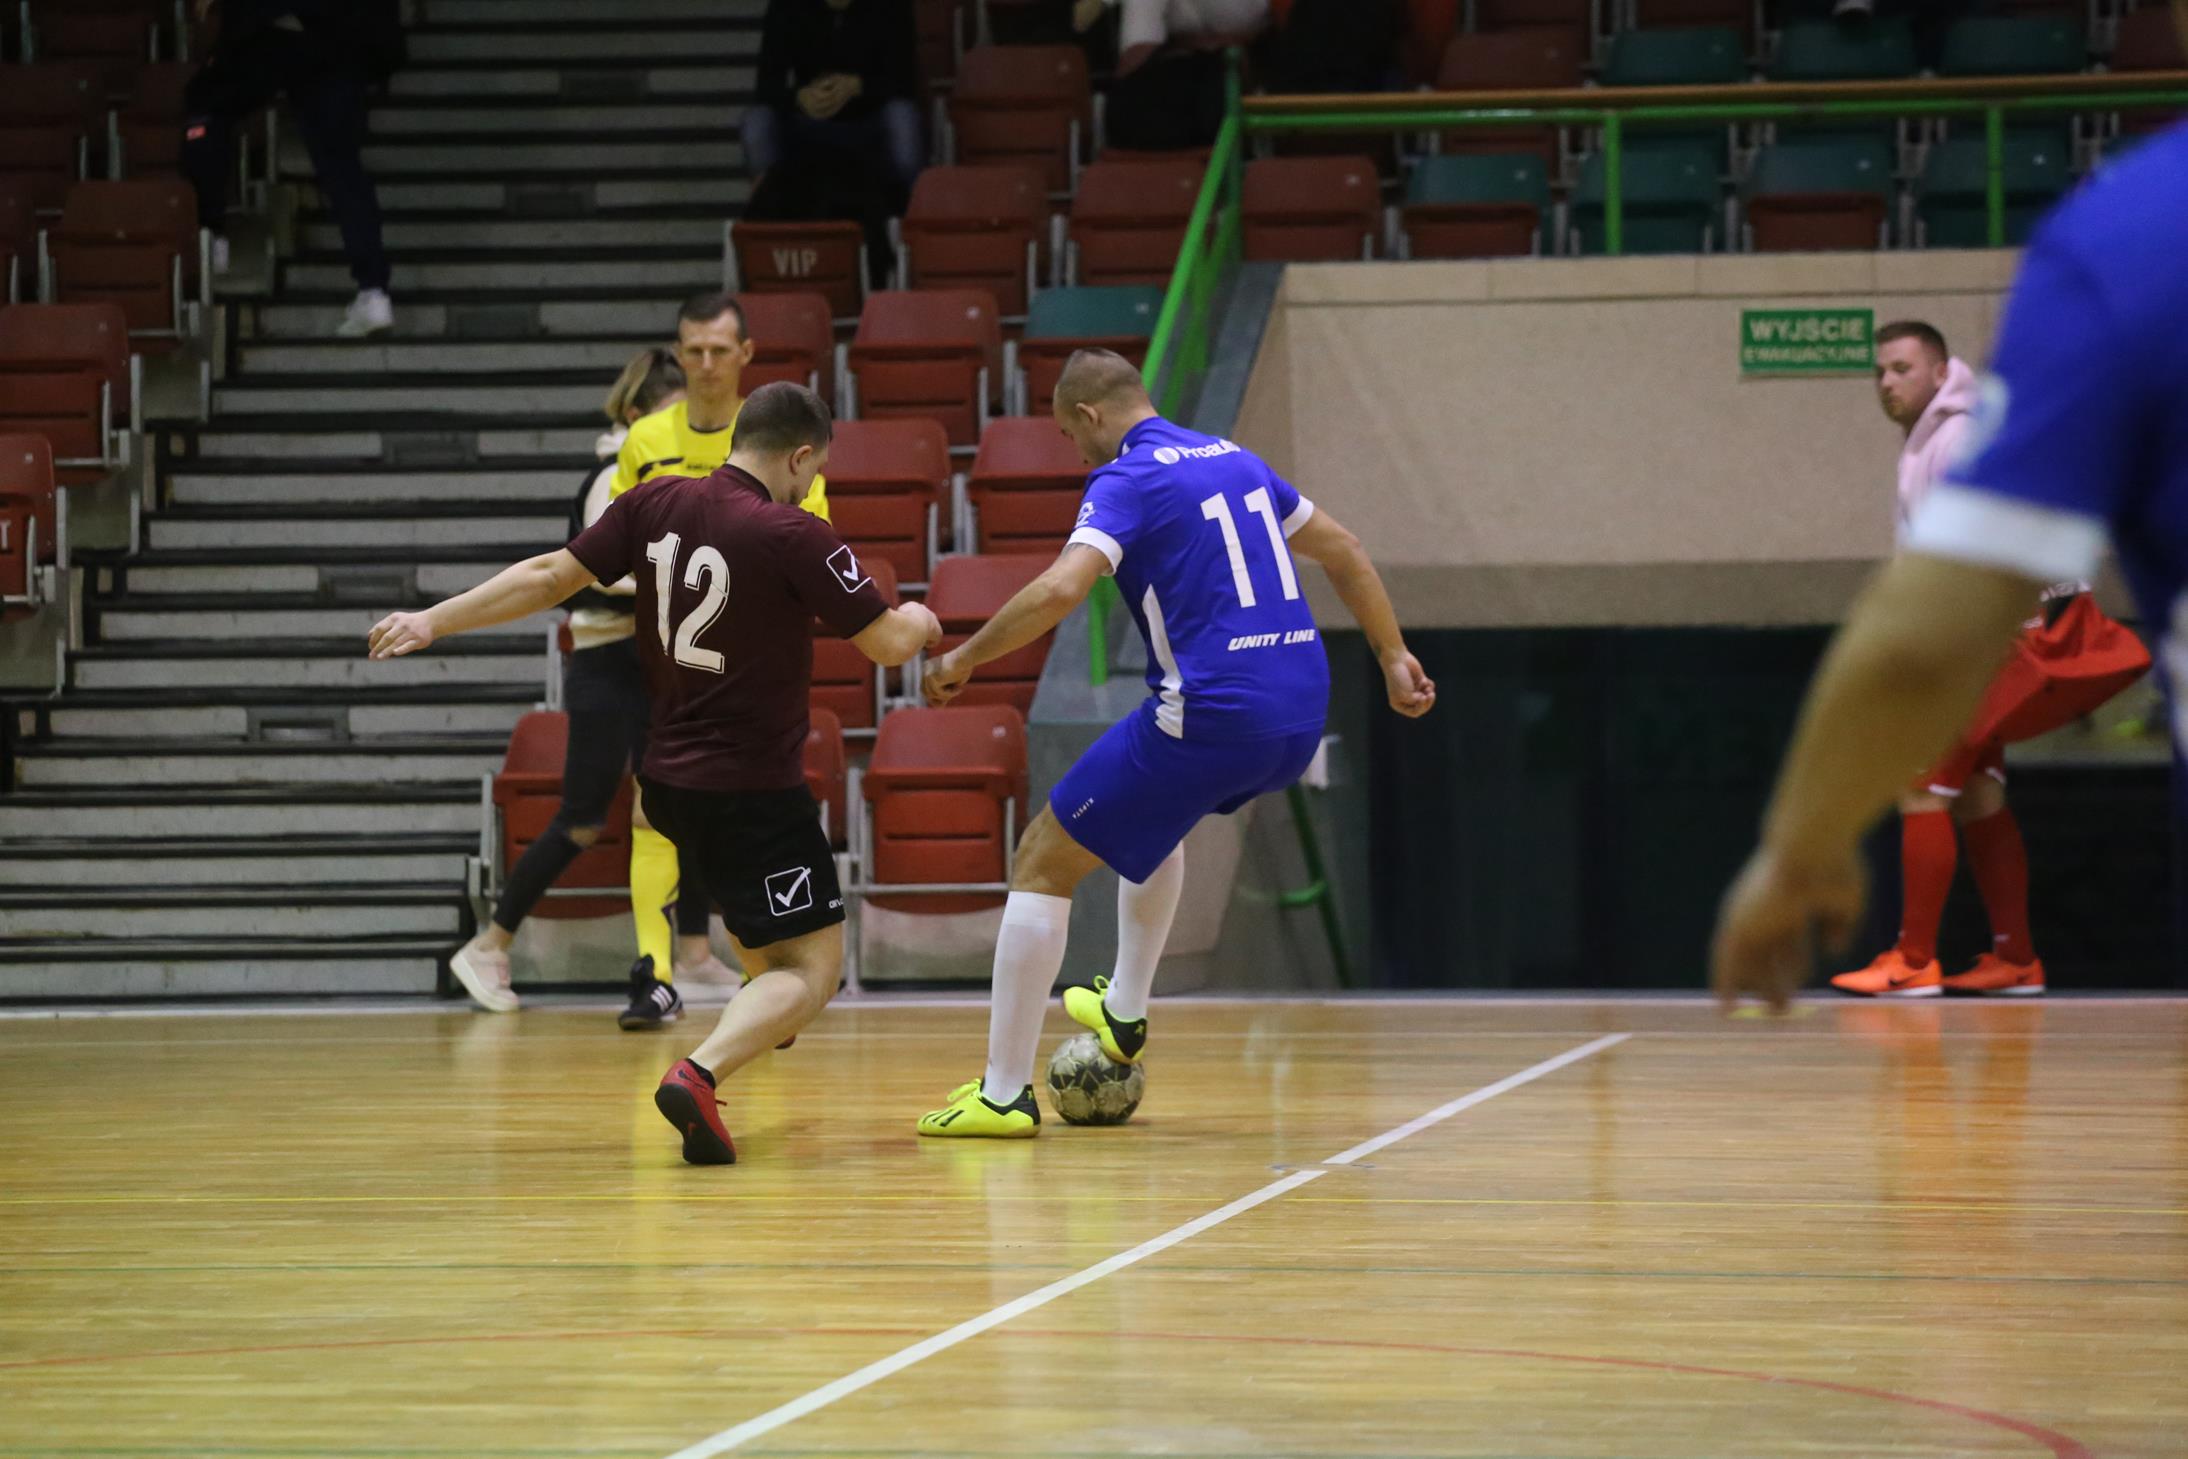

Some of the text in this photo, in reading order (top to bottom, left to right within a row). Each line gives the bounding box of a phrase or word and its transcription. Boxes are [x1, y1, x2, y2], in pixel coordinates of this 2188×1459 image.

[772, 248, 818, 278] VIP
[1750, 316, 1865, 341] WYJŚCIE
[1200, 486, 1300, 608] 11
[646, 532, 731, 674] 12
[1228, 629, 1315, 651] UNITY LINE
